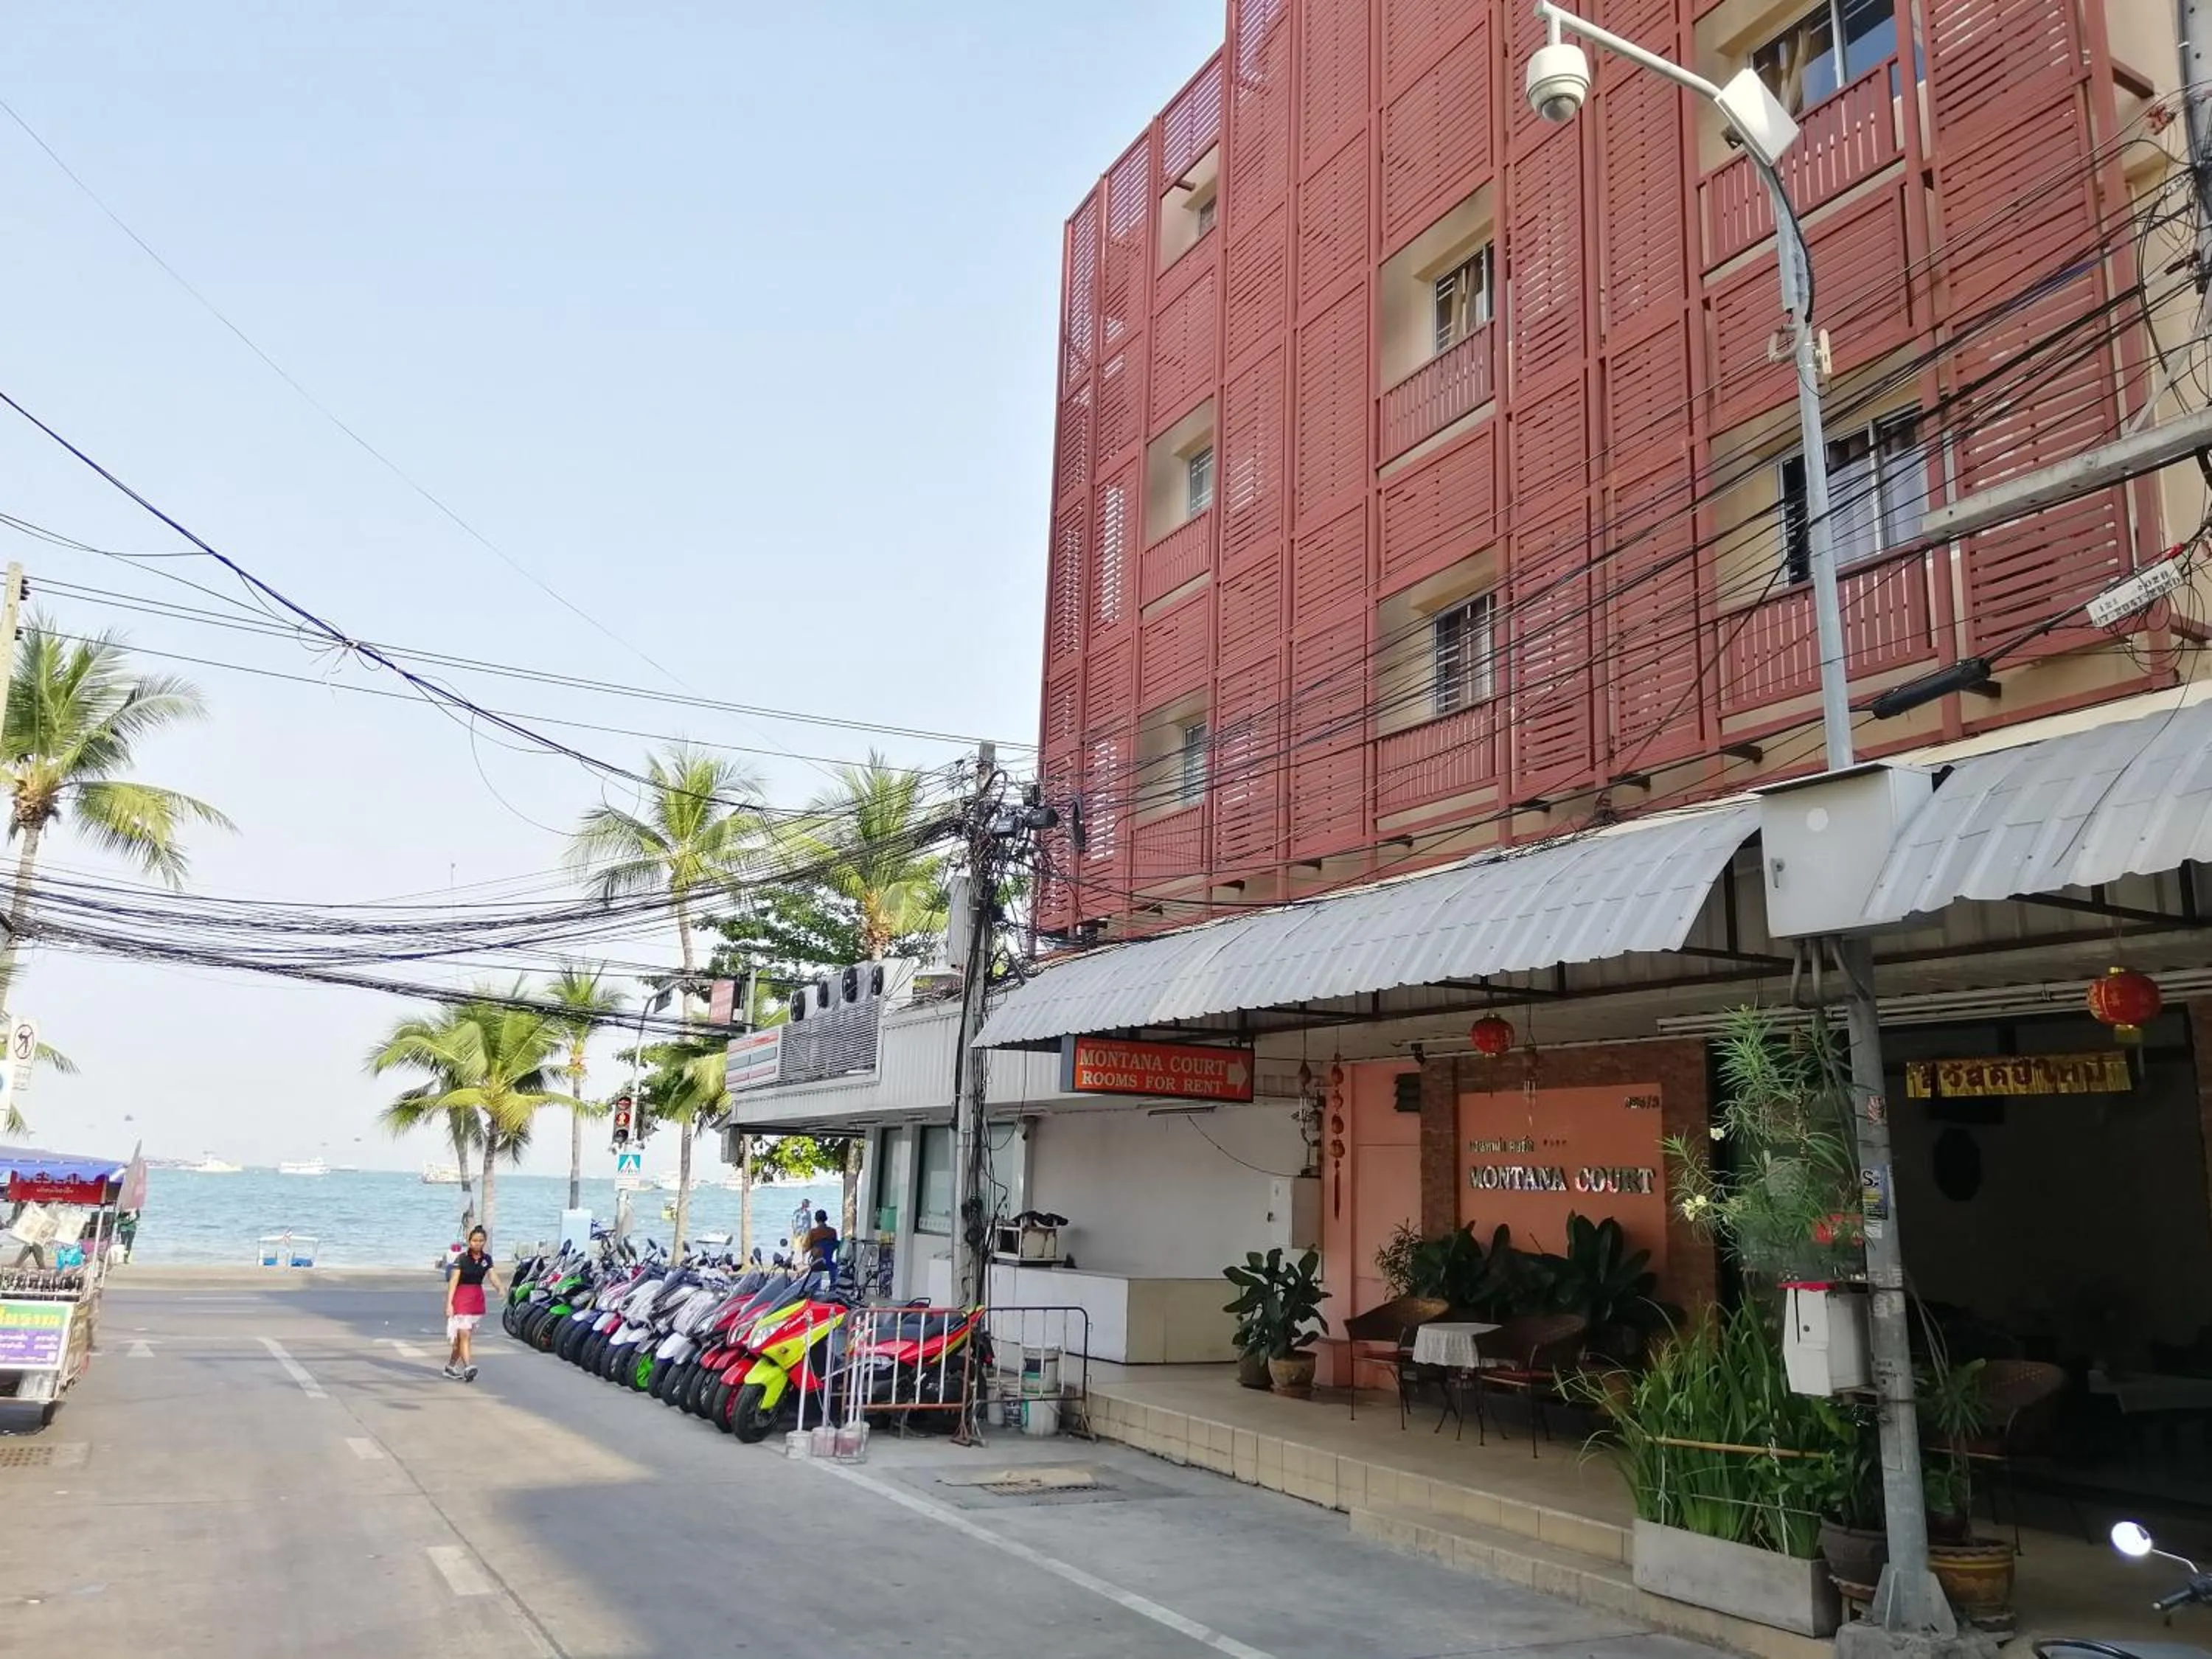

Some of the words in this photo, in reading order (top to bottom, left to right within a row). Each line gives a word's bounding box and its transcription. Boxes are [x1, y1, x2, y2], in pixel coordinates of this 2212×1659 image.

[1079, 1048, 1162, 1071] MONTANA
[1169, 1055, 1226, 1076] COURT
[1081, 1070, 1138, 1089] ROOMS
[1145, 1077, 1176, 1091] FOR
[1183, 1079, 1224, 1095] RENT
[1470, 1164, 1568, 1192] MONTANA
[1574, 1166, 1655, 1194] COURT
